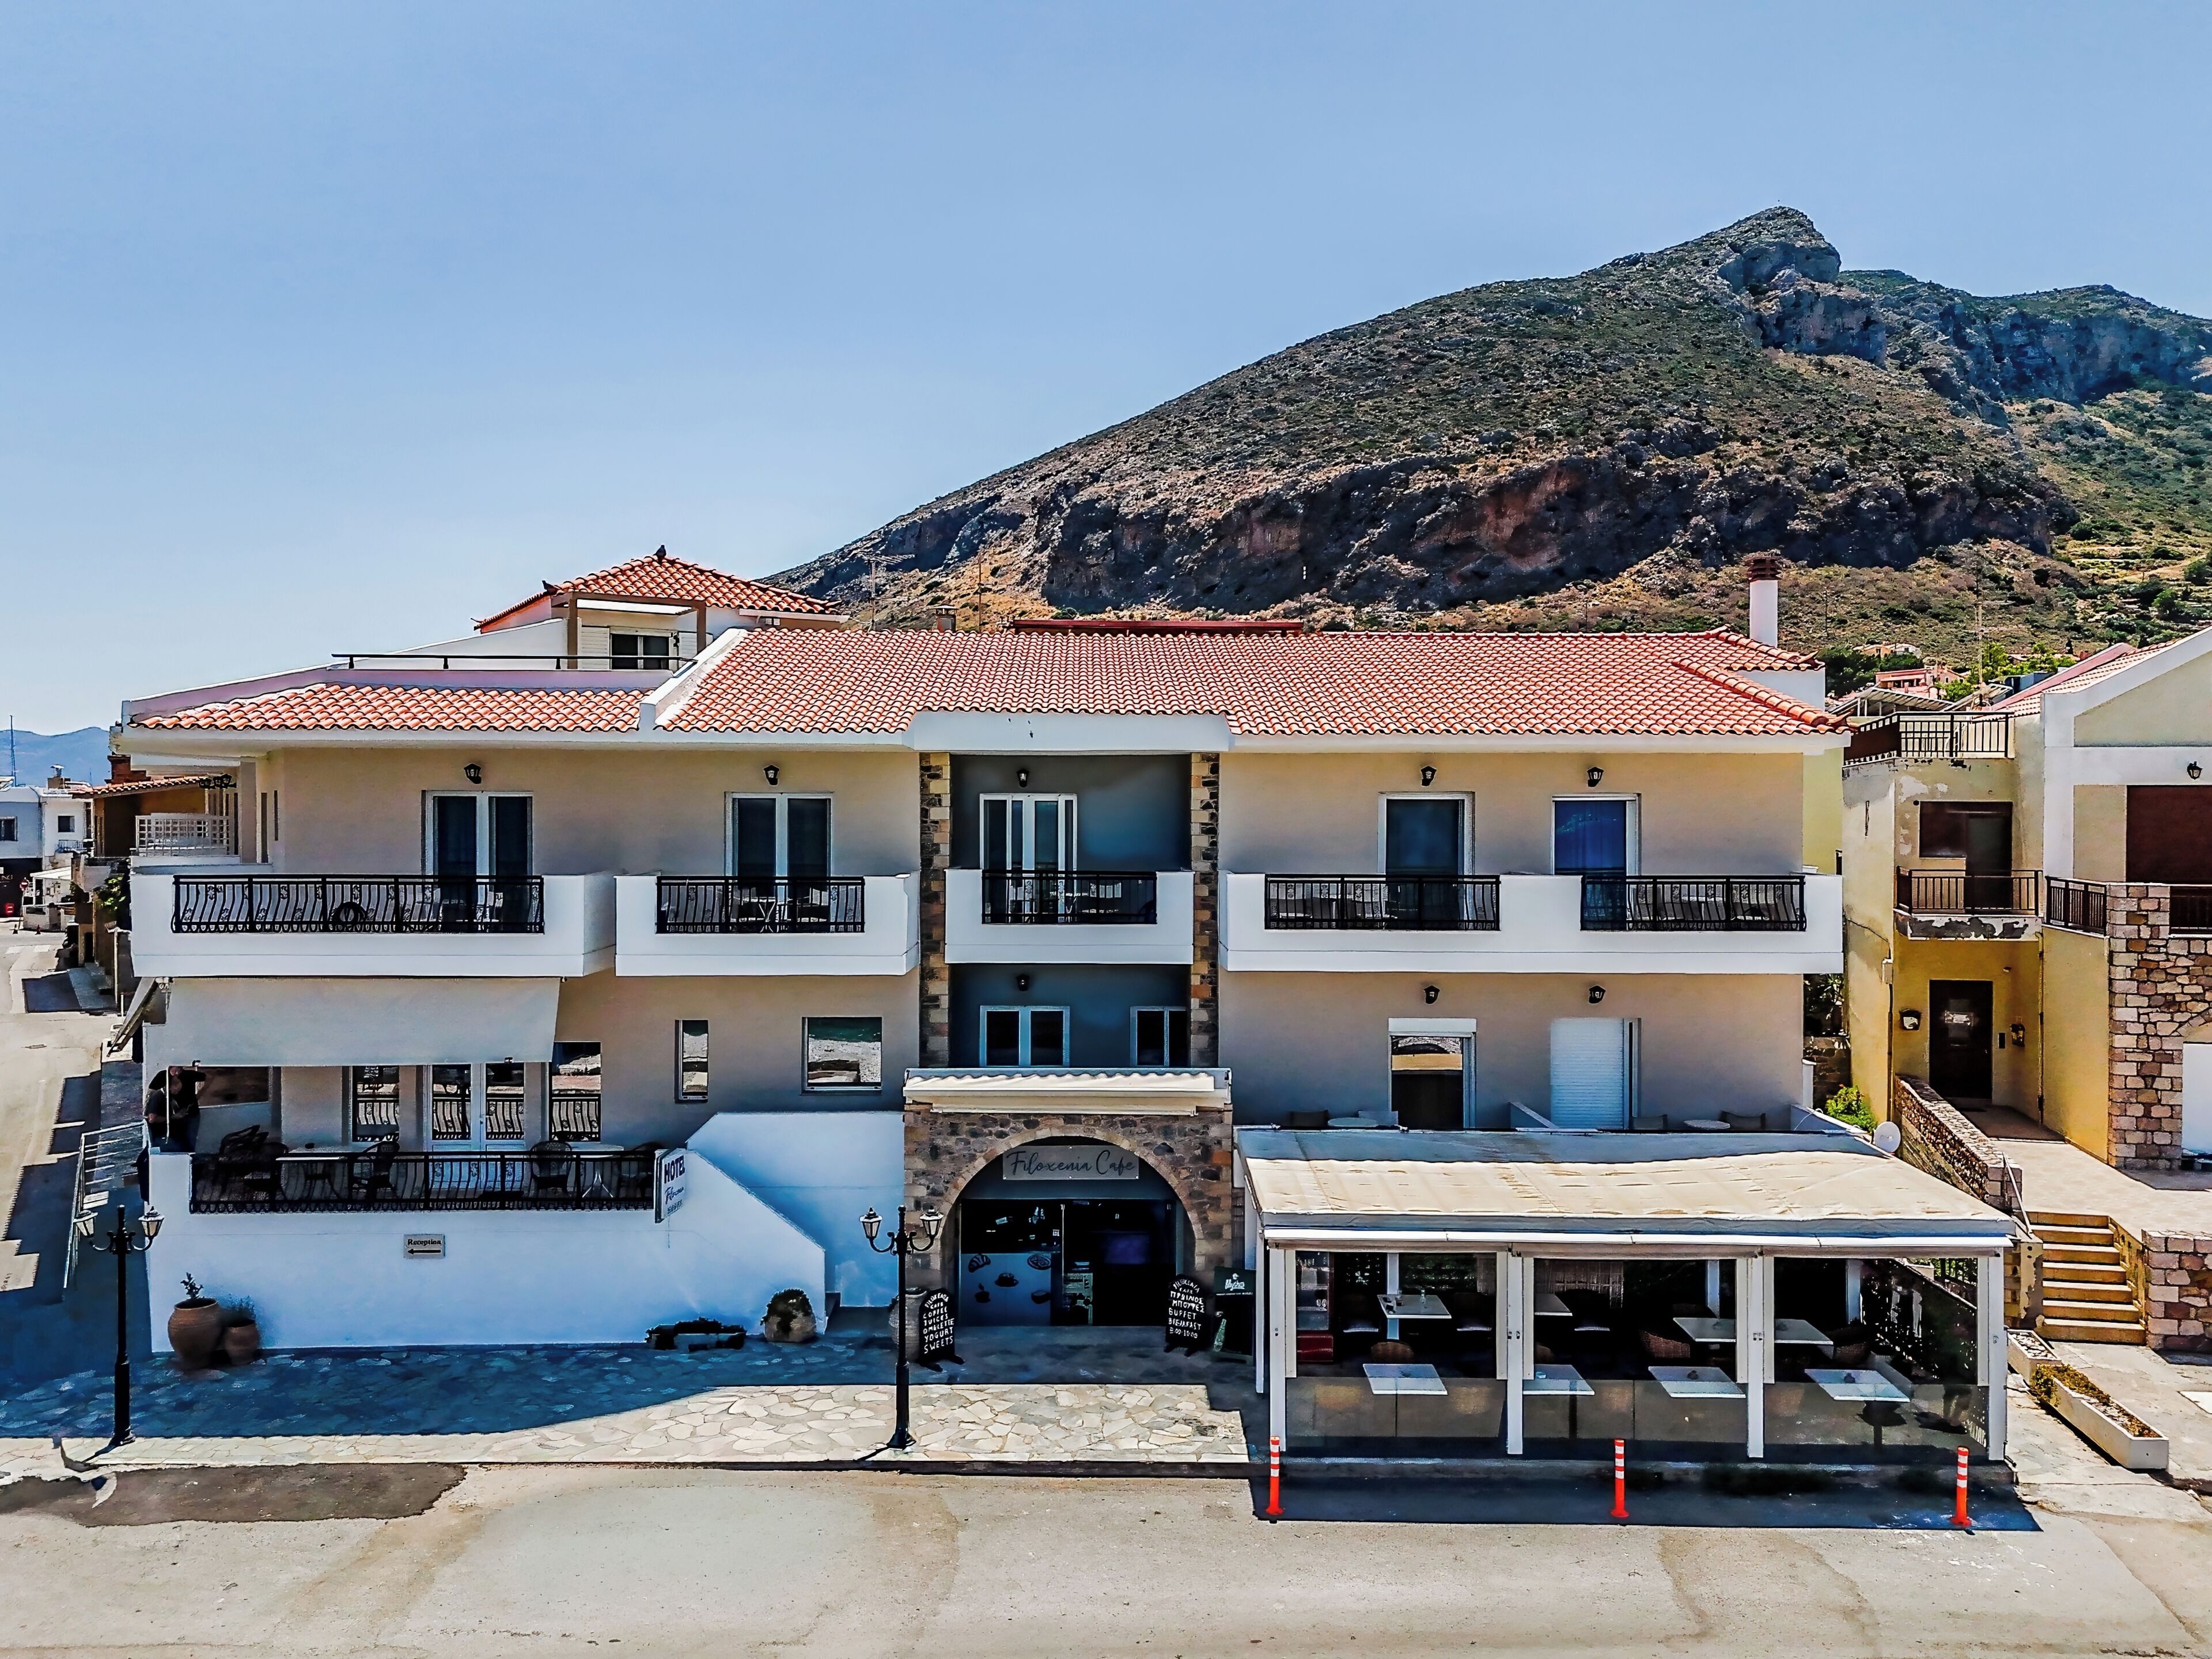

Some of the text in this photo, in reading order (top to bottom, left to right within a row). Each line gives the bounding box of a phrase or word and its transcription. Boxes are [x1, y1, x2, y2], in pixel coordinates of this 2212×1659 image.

[664, 1155, 685, 1184] HOTEL
[1006, 1150, 1136, 1176] Filoxenia Cafe
[924, 1327, 953, 1343] YOGURT
[924, 1335, 953, 1354] SWEETS
